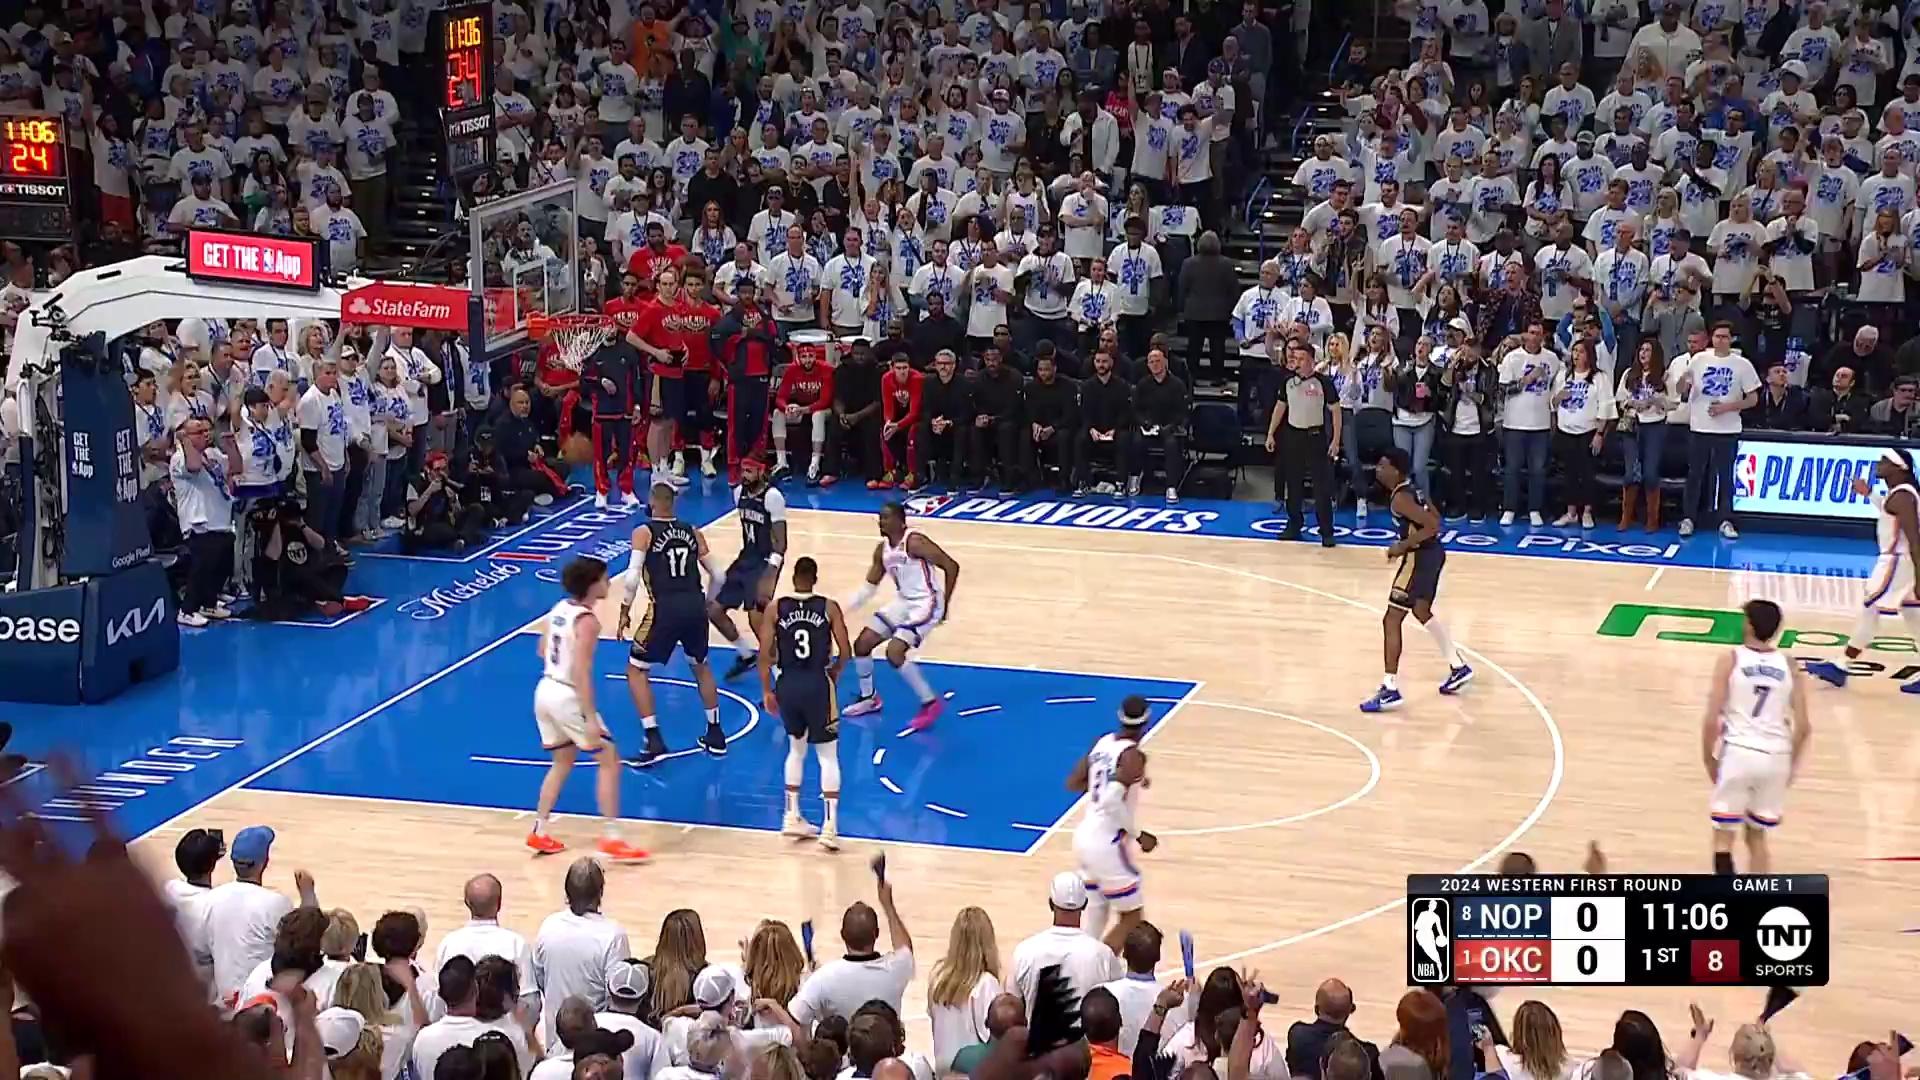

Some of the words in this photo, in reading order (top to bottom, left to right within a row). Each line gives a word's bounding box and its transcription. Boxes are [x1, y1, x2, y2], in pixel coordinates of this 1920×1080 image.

[449, 17, 481, 49] 11:06
[447, 50, 480, 107] 24
[7, 121, 55, 143] 11:06
[461, 115, 490, 135] TISSOT
[12, 143, 48, 171] 24
[16, 184, 65, 196] TISSOT
[203, 242, 229, 269] GET
[232, 245, 259, 272] THE
[275, 248, 301, 280] App
[73, 431, 88, 447] GET
[74, 446, 90, 461] THE
[116, 428, 130, 453] GET
[79, 461, 94, 479] App
[117, 451, 133, 477] THE
[1760, 454, 1887, 505] PLAYOFF
[941, 497, 1219, 533] PLAYOFFS
[1250, 518, 1499, 547] Goole
[1516, 534, 1681, 559] Pixel
[112, 552, 135, 569] Google
[135, 543, 151, 560] Pixel
[666, 546, 689, 577] 17
[397, 561, 521, 621] Michelob
[794, 628, 811, 659] 3
[1752, 685, 1771, 718] 7
